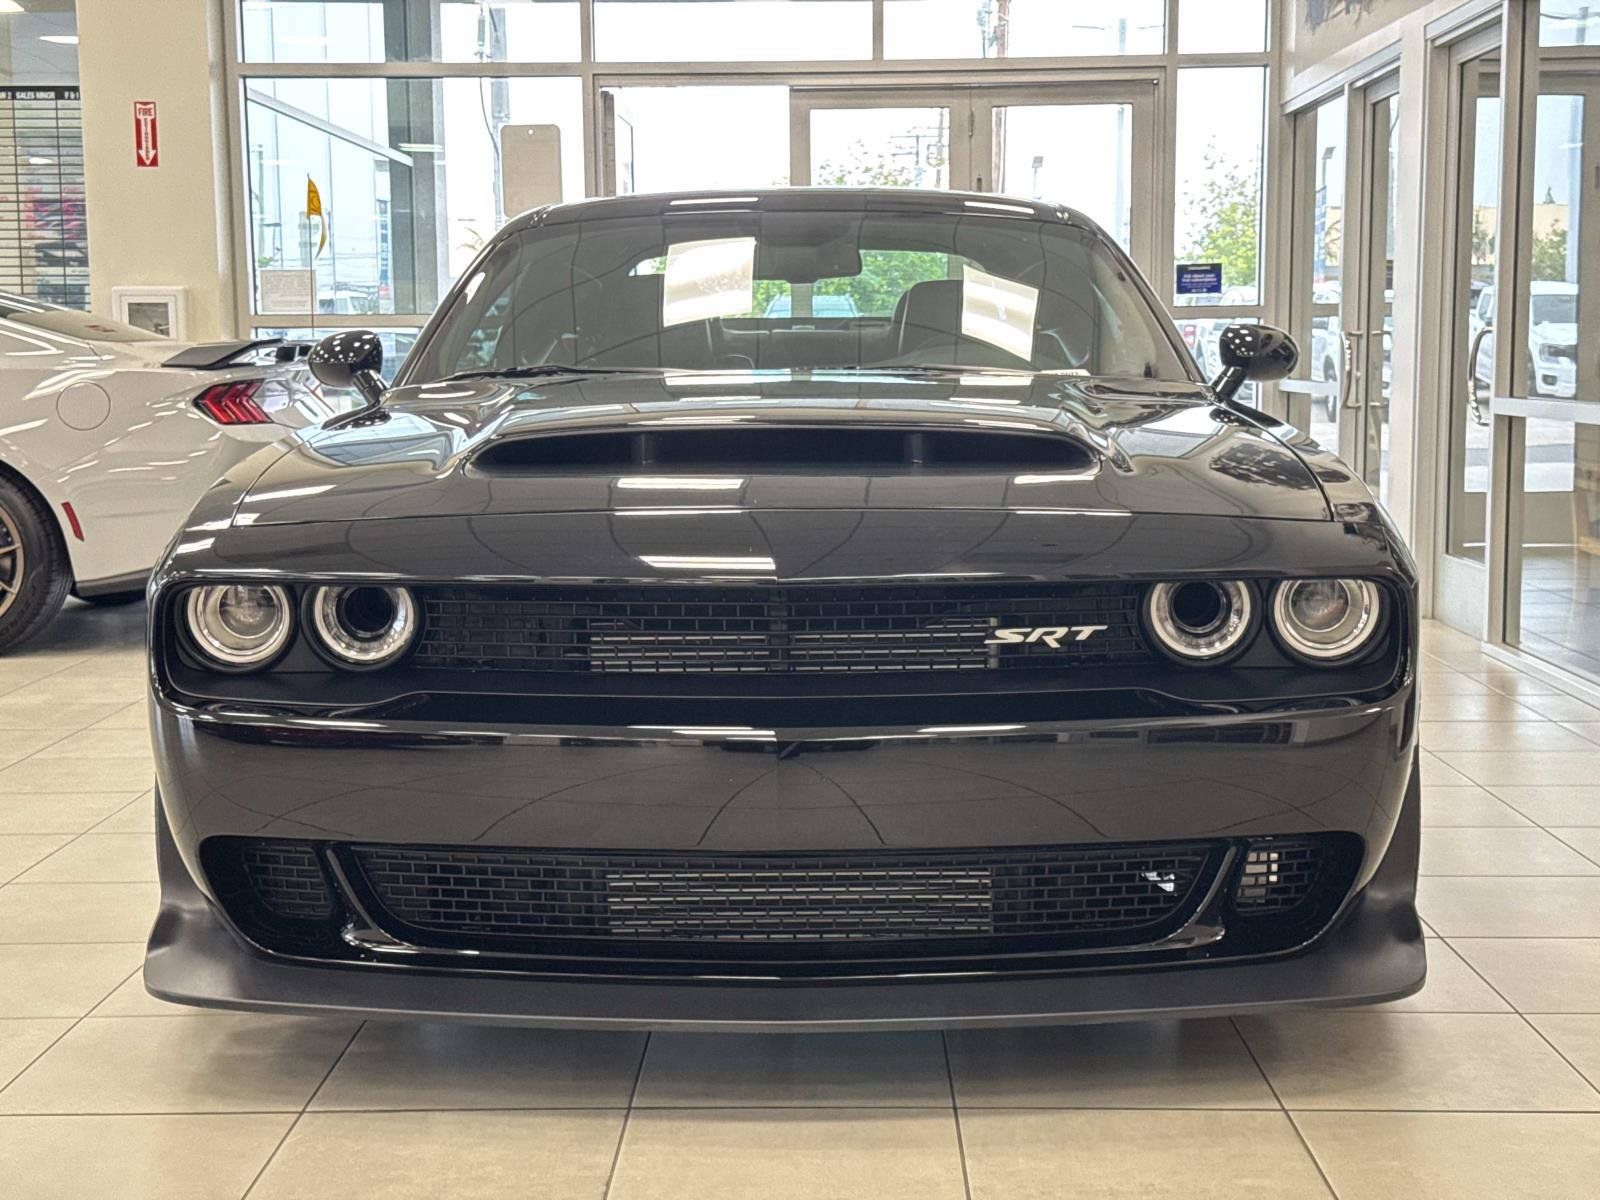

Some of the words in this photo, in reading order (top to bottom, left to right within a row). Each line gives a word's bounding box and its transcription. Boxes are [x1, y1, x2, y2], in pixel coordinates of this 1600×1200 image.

[16, 91, 35, 99] SALES
[138, 108, 153, 116] FIRE
[983, 625, 1109, 648] SRT
